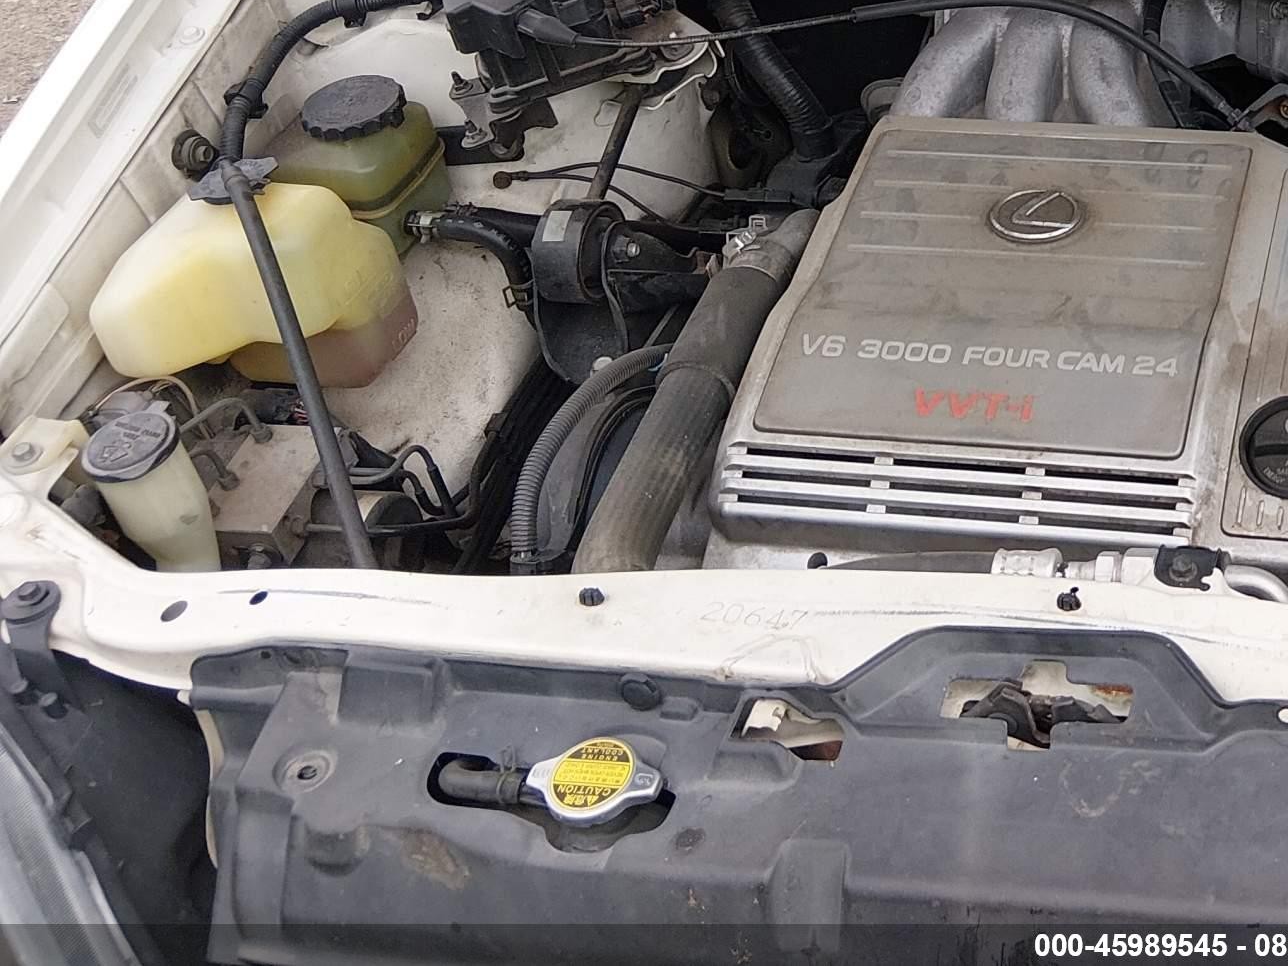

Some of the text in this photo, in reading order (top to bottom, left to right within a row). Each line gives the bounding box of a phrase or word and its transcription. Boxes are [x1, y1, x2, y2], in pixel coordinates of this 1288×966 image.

[801, 334, 1178, 377] V6 3000 FOUR CAM 24
[580, 747, 624, 756] COOLANT
[581, 753, 618, 761] ENGINE
[557, 784, 611, 797] CAUTION
